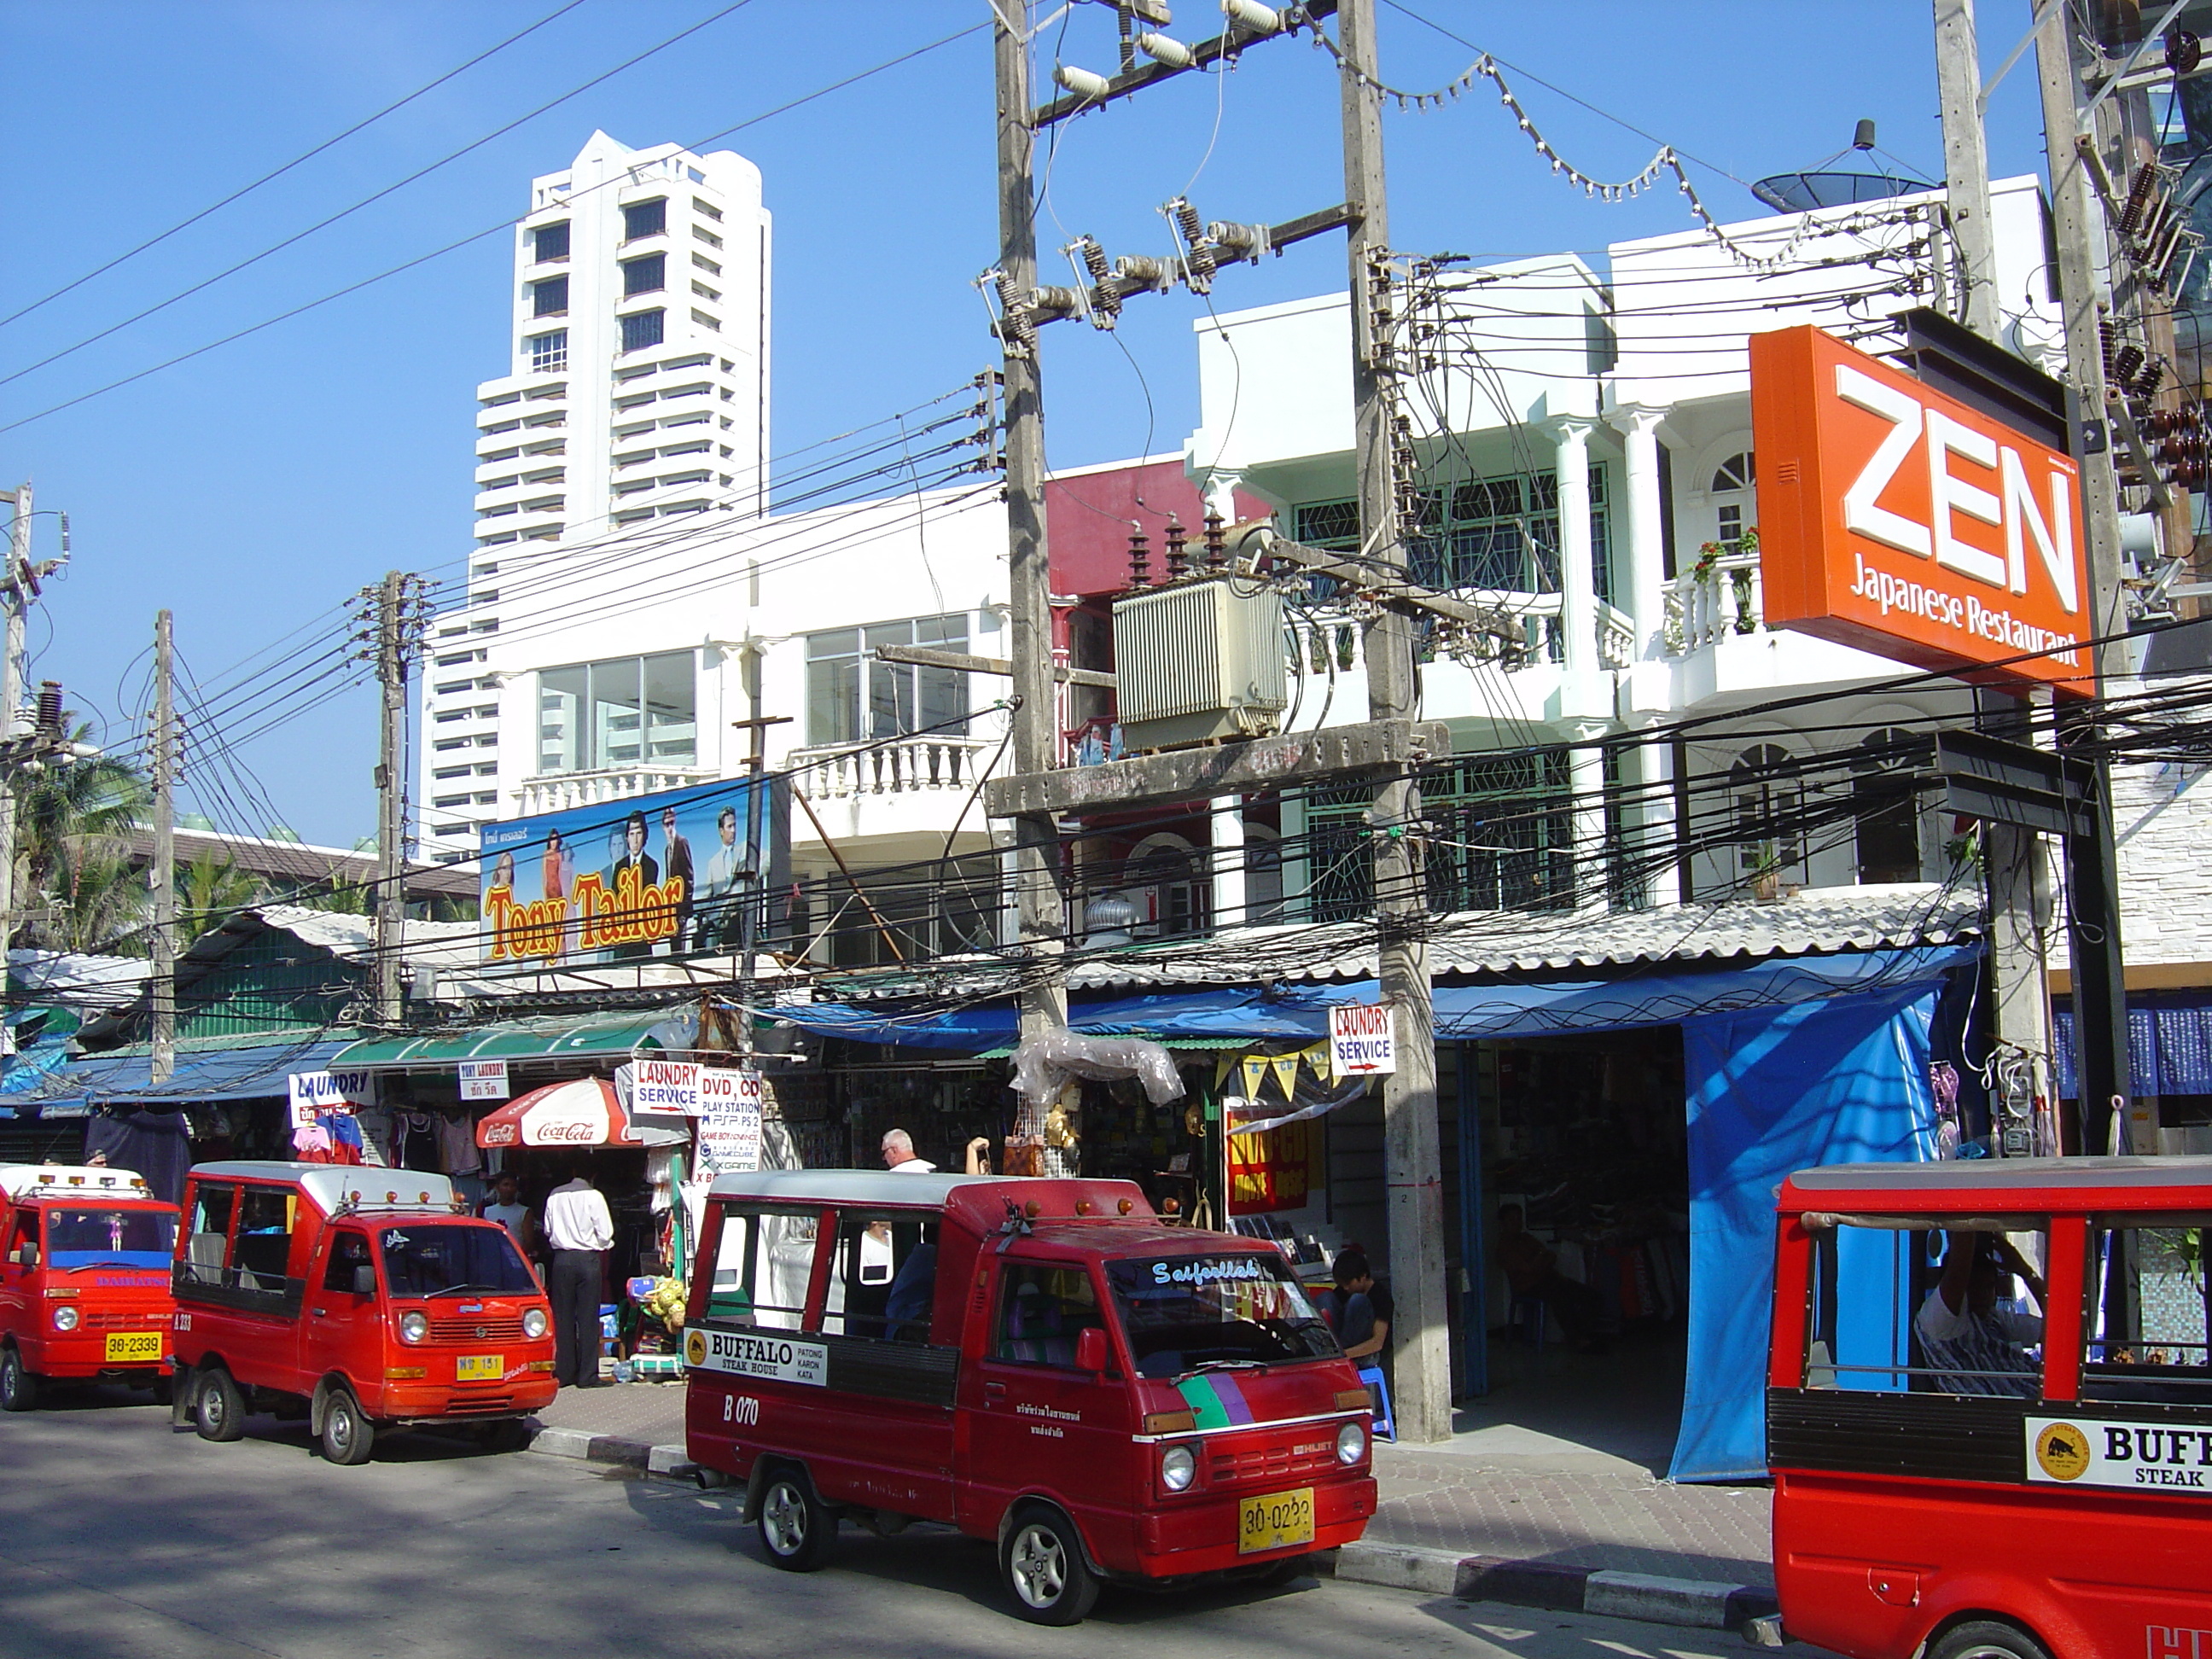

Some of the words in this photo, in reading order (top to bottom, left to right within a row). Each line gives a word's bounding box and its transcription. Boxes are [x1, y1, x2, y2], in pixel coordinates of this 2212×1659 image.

[1834, 364, 2078, 615] ZEN
[1851, 552, 1964, 629] Japanese
[1966, 595, 2079, 668] Restaurant
[486, 885, 568, 966] Tony
[573, 863, 684, 951] Tailor
[1336, 1008, 1388, 1036] LAUNDRY
[1338, 1040, 1390, 1060] SERVICE
[478, 1063, 504, 1076] LAUNDRY
[639, 1062, 698, 1086] LAUNDRY
[1251, 1062, 1260, 1074] &
[1280, 1060, 1293, 1071] CD
[298, 1072, 368, 1098] LAUNDRY
[741, 1080, 759, 1097] CD
[639, 1088, 697, 1104] SERVICE
[703, 1102, 723, 1112] PLAY
[725, 1103, 760, 1115] STATION
[537, 1122, 594, 1141] Coca-Cola
[1401, 1194, 1407, 1203] 2
[712, 1334, 793, 1365] BUFFALO
[797, 1348, 823, 1359] PATONG
[722, 1359, 748, 1371] STEAK
[751, 1362, 778, 1376] HOUSE
[797, 1359, 819, 1371] KARON
[797, 1370, 813, 1380] KATA
[724, 1394, 734, 1422] B
[736, 1396, 759, 1426] 070
[2135, 1468, 2204, 1487] STEAK
